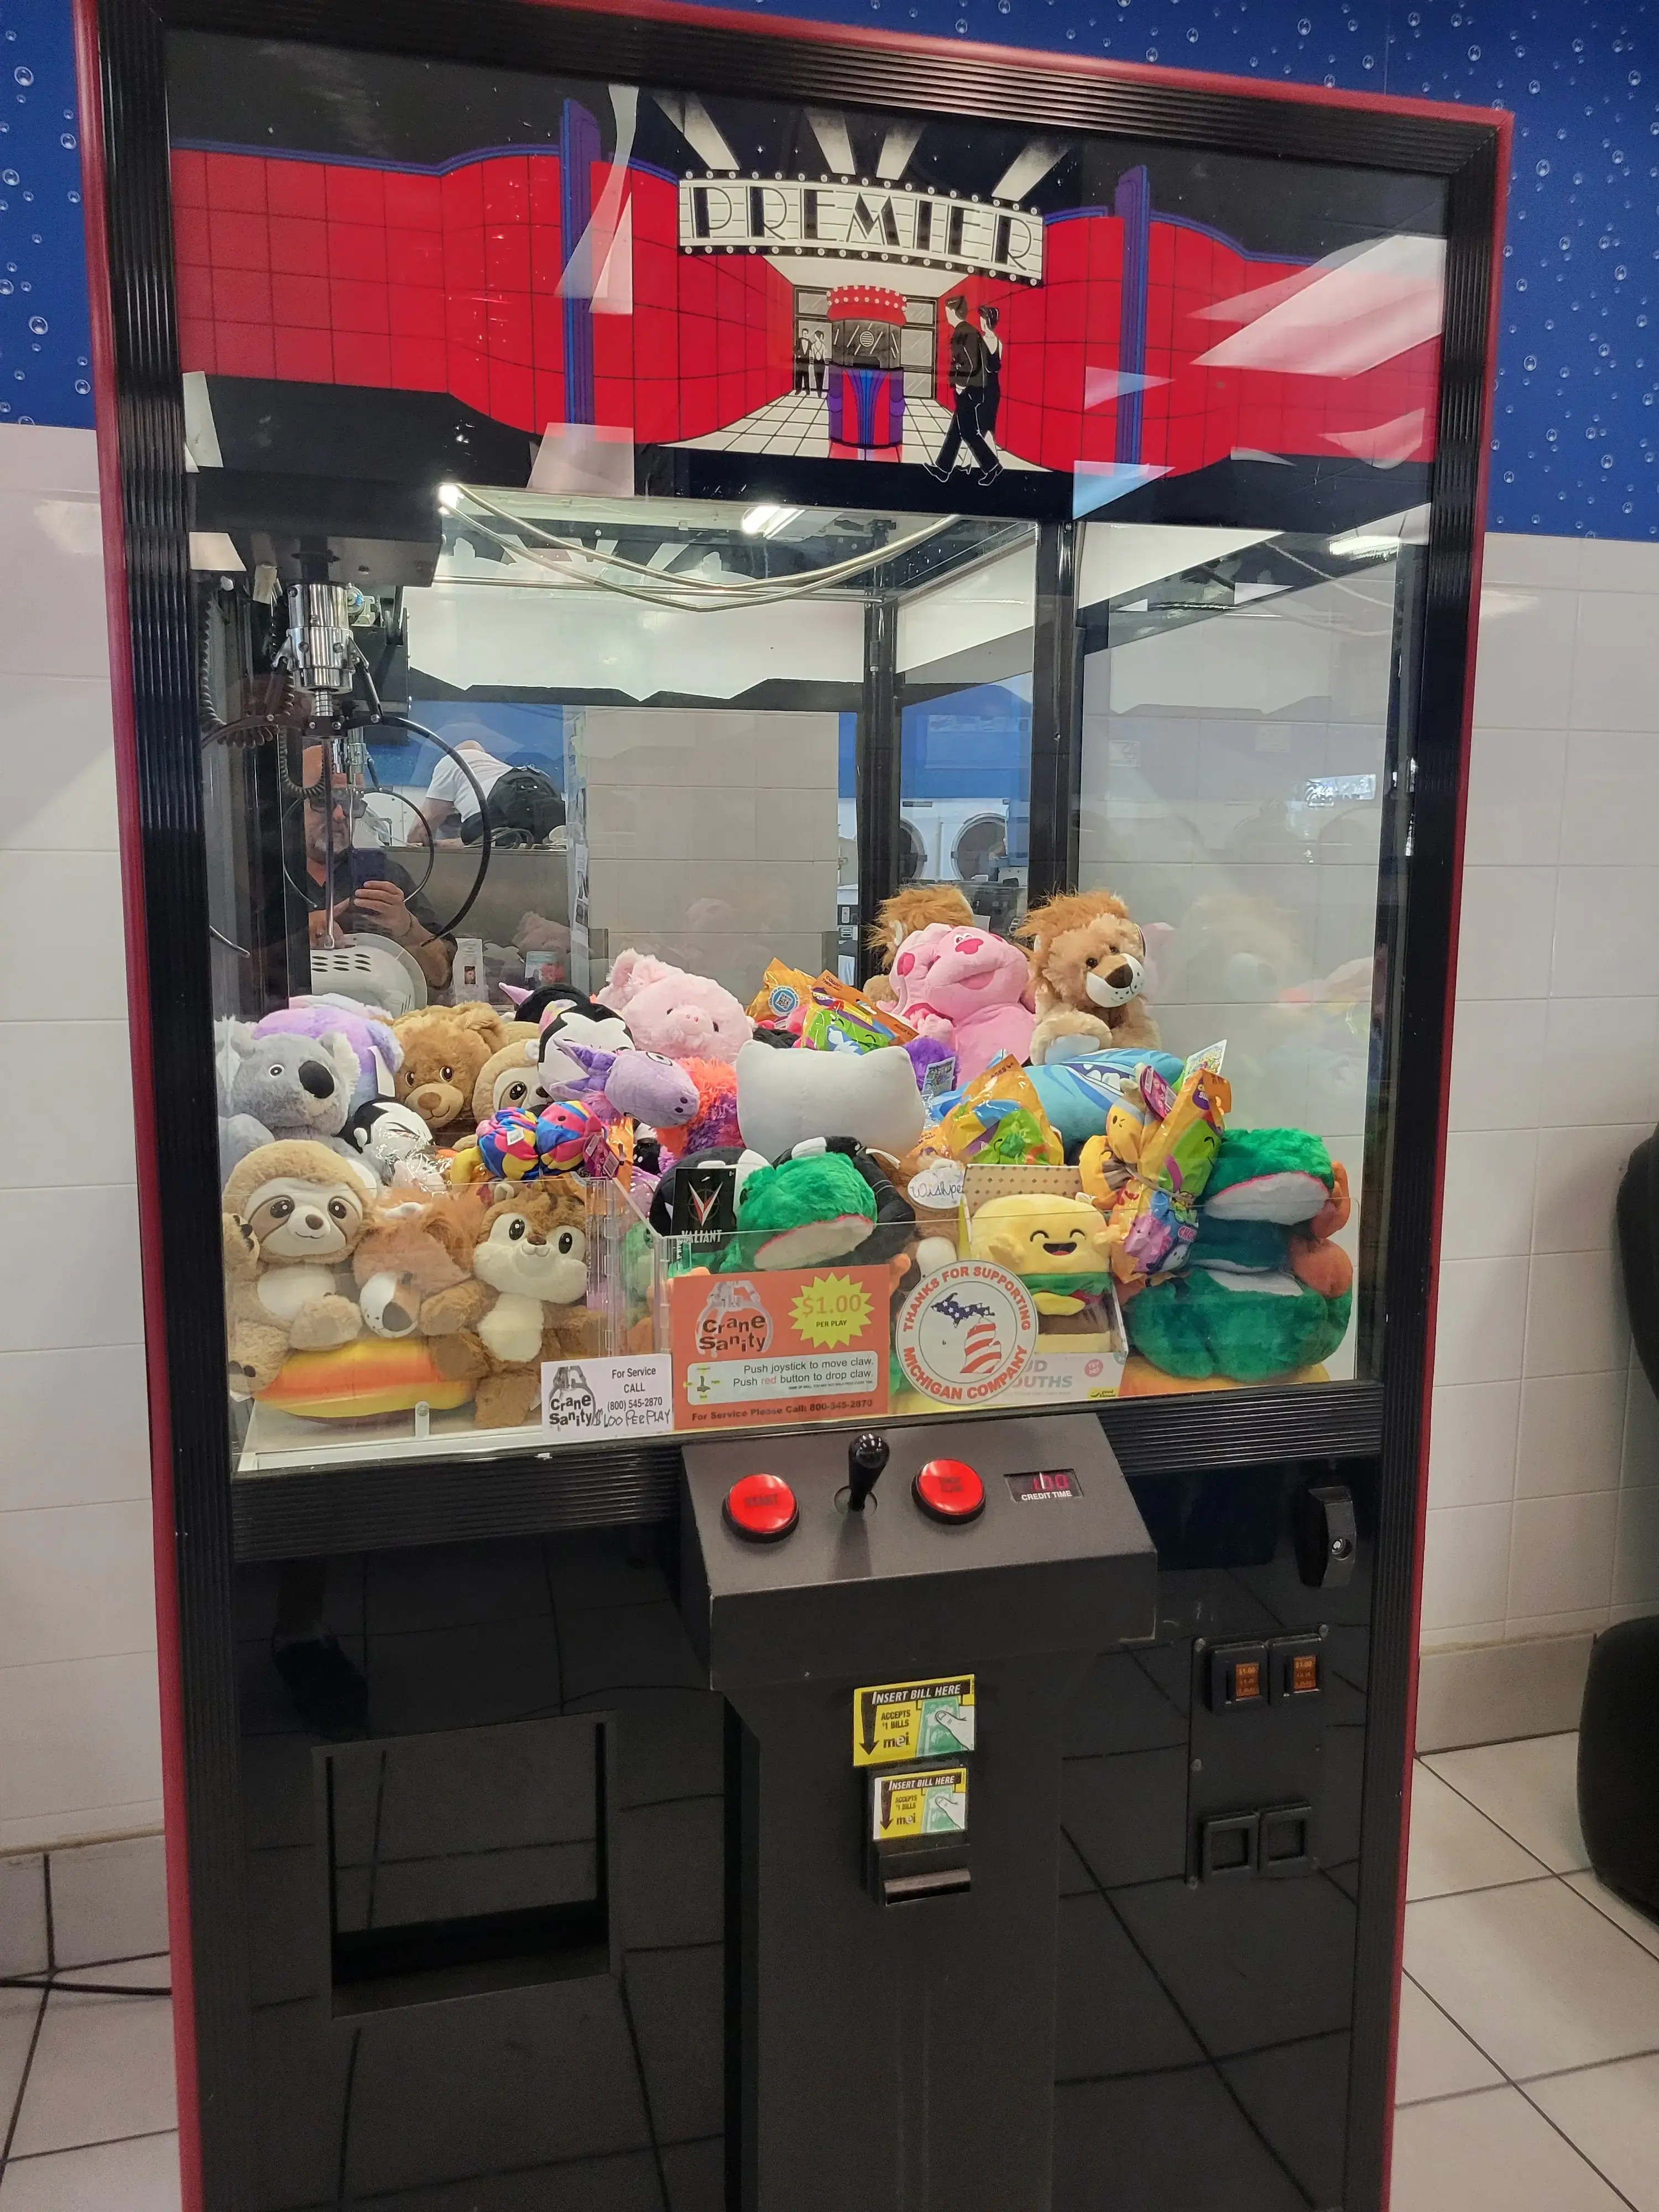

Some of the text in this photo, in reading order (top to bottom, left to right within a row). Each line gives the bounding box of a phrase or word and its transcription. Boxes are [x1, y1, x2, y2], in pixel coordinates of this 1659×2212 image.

[688, 185, 1033, 270] PREMIER
[910, 1181, 963, 1199] Wishpe
[681, 1229, 723, 1244] VALIANT
[802, 1294, 862, 1318] $1.00
[903, 1266, 1031, 1332] THANKS FOR SUPPORTING
[702, 1314, 766, 1334] Crane
[699, 1332, 766, 1352] Sanity
[612, 1366, 656, 1379] For Service
[743, 1357, 874, 1374] Push joystick to move claw.
[903, 1344, 1027, 1400] MICHIGAN COMPANY
[733, 1369, 873, 1387] Push red button to drop claw.
[624, 1383, 645, 1393] CALL
[550, 1394, 592, 1411] Crane
[607, 1396, 662, 1412] (800) 545-2870
[692, 1413, 708, 1422] For
[710, 1410, 748, 1420] Service
[750, 1407, 783, 1416] Please
[809, 1399, 873, 1412] 800-545-2870
[549, 1409, 592, 1427] Sanity
[1021, 1490, 1072, 1501] CREDIT TIME
[872, 1691, 908, 1704] INSERT
[910, 1689, 932, 1700] BILL
[935, 1684, 961, 1696] HERE
[881, 1709, 911, 1720] ACCEPTS
[890, 1719, 909, 1729] BILLS
[883, 1731, 911, 1749] mei
[888, 1775, 955, 1791] INSERT BILL HERE
[895, 1794, 917, 1804] ACCEPTS
[902, 1802, 916, 1811] BILLS
[896, 1812, 916, 1825] mei
